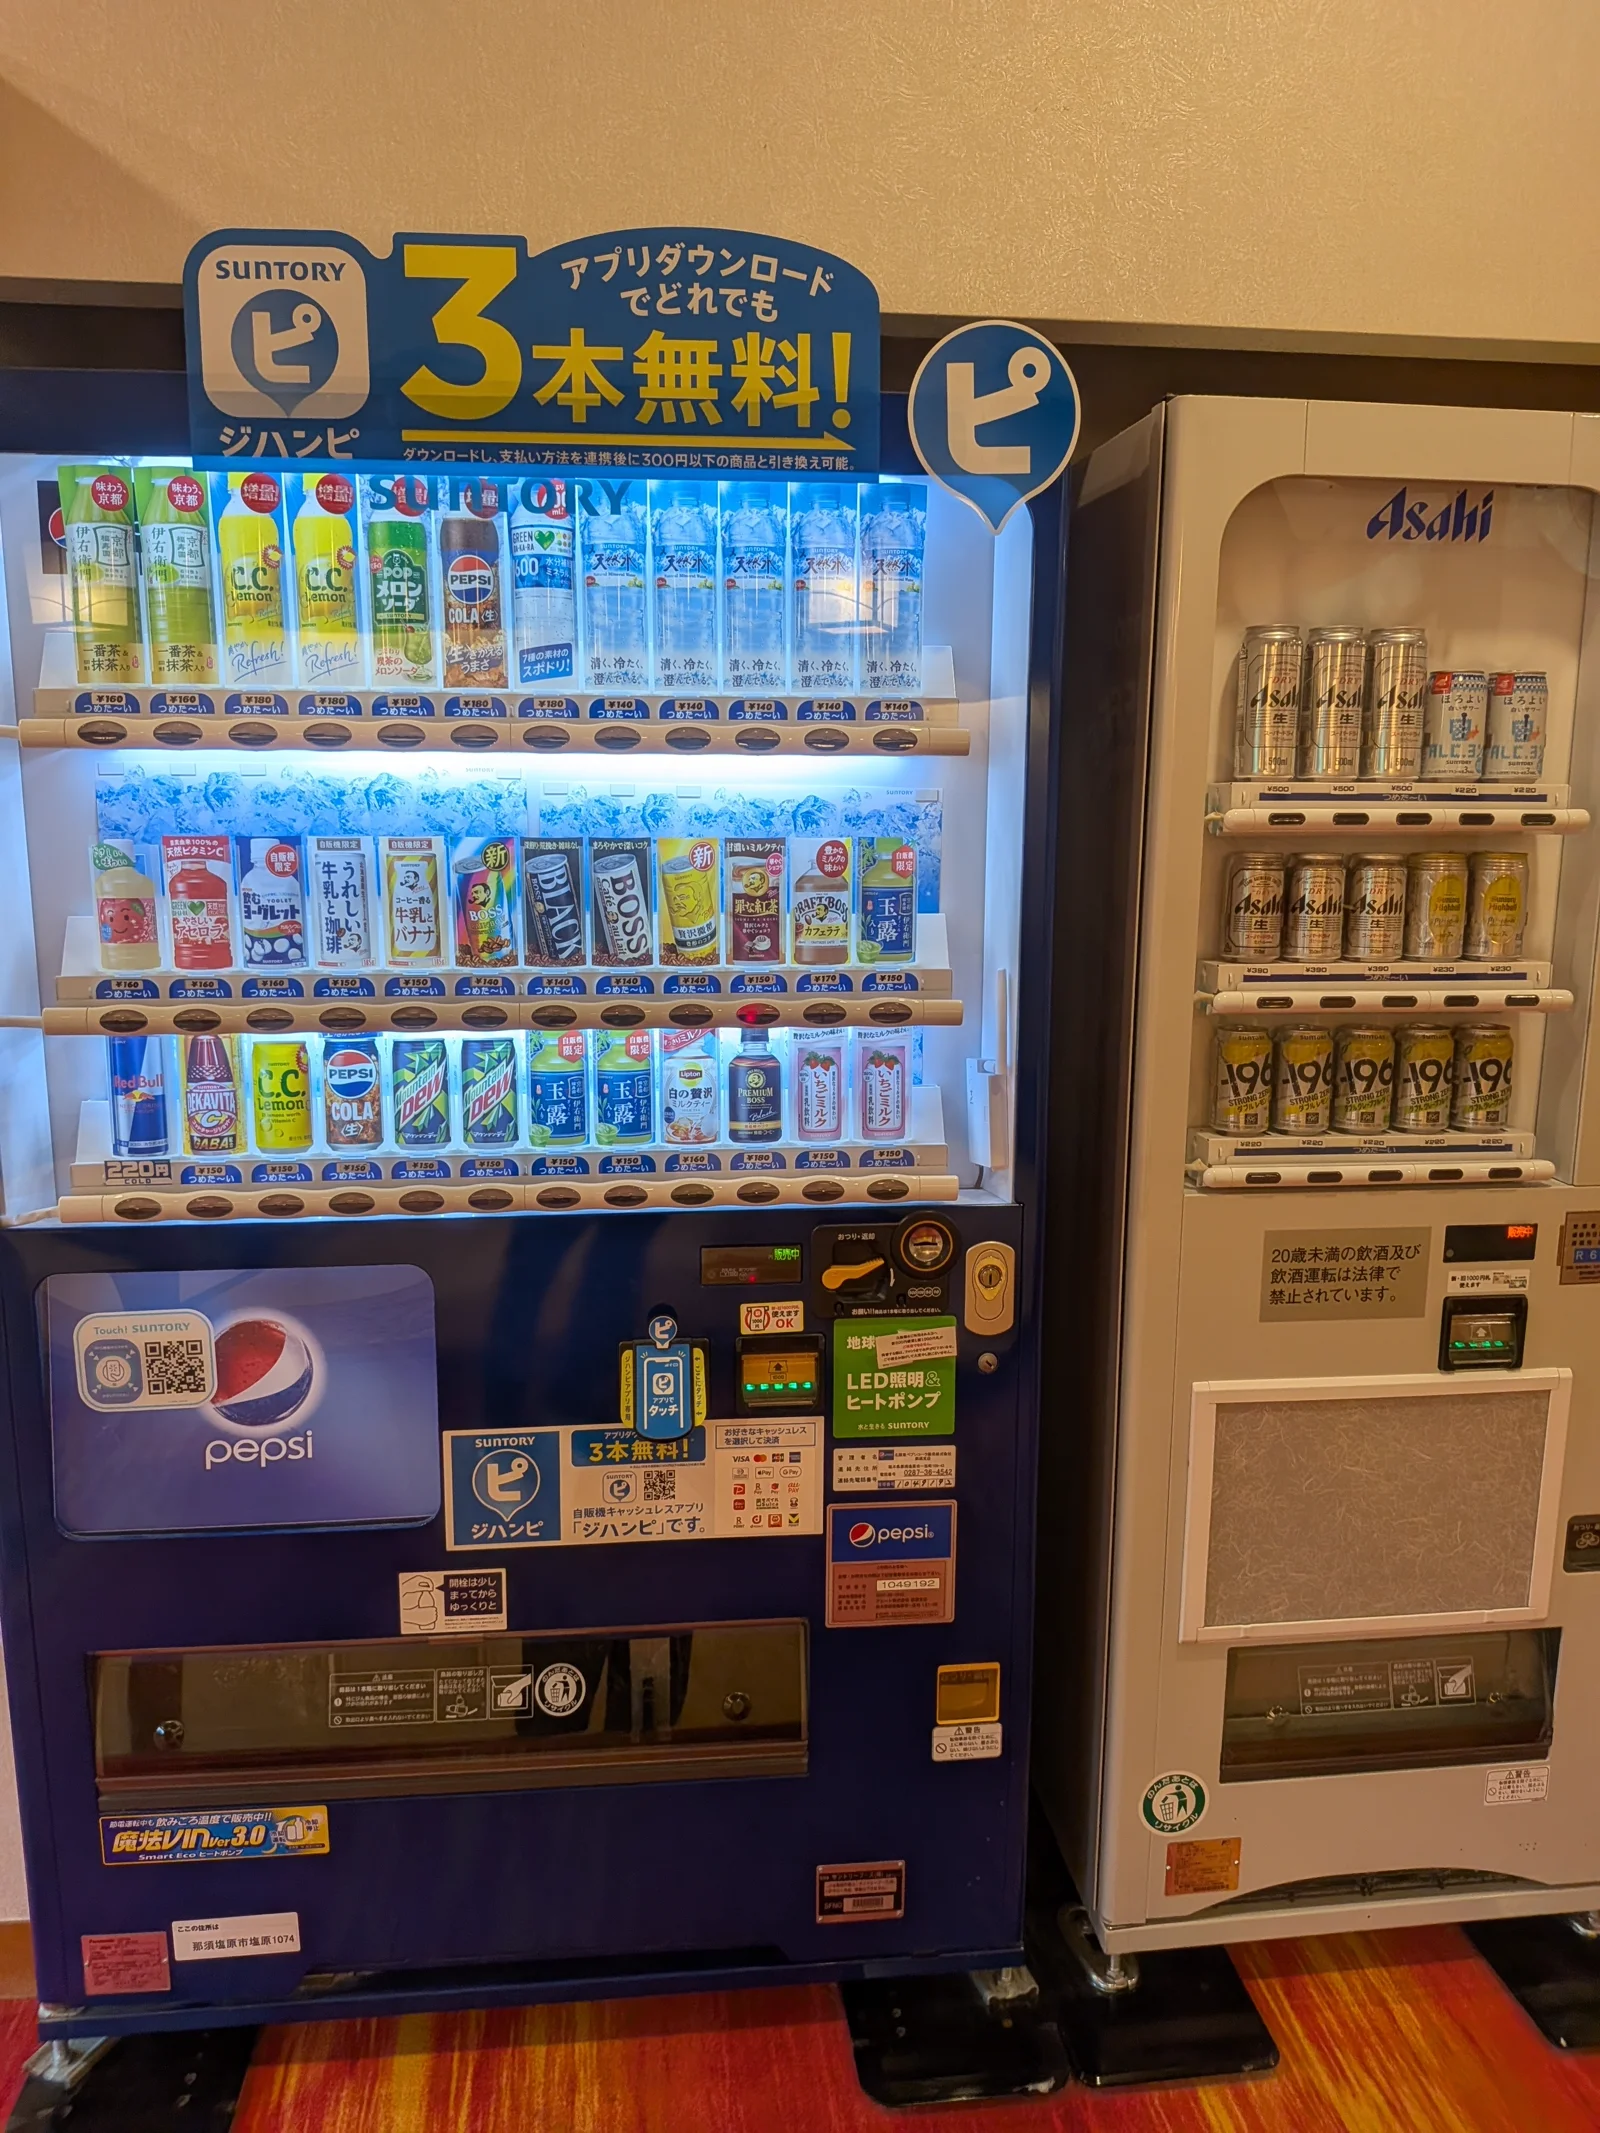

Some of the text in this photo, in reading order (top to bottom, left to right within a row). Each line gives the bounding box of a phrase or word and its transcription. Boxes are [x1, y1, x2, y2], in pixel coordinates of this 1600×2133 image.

[214, 258, 347, 285] SUNTORY
[561, 241, 838, 298] アプリダウンロード
[619, 283, 780, 323] でどれでも
[250, 301, 322, 384] ピ
[945, 345, 1052, 475] ピ
[217, 425, 360, 459] ジハンピ
[97, 493, 123, 505] 京都
[173, 494, 199, 507] 京都
[1366, 486, 1495, 544] Asahi
[592, 553, 638, 573] 天然水
[663, 554, 708, 574] 天然水
[383, 567, 413, 580] POP
[450, 574, 492, 586] PEPSI
[376, 580, 423, 599] メロン
[381, 597, 420, 612] ソーダ
[448, 608, 479, 624] COLA
[522, 648, 569, 664] 7種の素材の
[460, 659, 490, 674] うまさ
[522, 659, 570, 679] スポドリ!
[95, 694, 125, 704] ¥160
[168, 695, 198, 705] ¥160
[243, 695, 273, 705] ¥180
[317, 696, 346, 706] ¥180
[606, 700, 634, 710] ¥140
[676, 701, 704, 711] ¥140
[747, 702, 773, 712] ¥140
[1273, 713, 1288, 725] 生
[1267, 785, 1290, 793] ¥500
[1332, 785, 1355, 793] ¥500
[166, 844, 224, 858] 天然ビタミンC
[269, 851, 296, 863] 自販機
[484, 843, 507, 867] 新
[691, 843, 713, 869] 新
[274, 861, 293, 873] 限定
[821, 854, 846, 865] ミルクの
[895, 860, 914, 872] 限定
[823, 863, 845, 873] 味わい
[243, 891, 261, 904] 飲む
[340, 861, 361, 932] うれしい
[243, 904, 300, 921] ヨーグレット
[321, 860, 343, 955] 牛乳と珈琲
[469, 902, 503, 922] BOSS
[537, 864, 584, 960] BLACK
[609, 869, 648, 954] BOSS
[734, 898, 779, 915] 罪な紅茶
[182, 916, 213, 926] やさしい
[394, 906, 434, 925] 牛乳と
[876, 896, 898, 942] 玉露
[176, 924, 224, 940] アセロラ
[395, 925, 436, 945] バナナ
[804, 926, 841, 937] カフェラテ
[1246, 967, 1269, 975] ¥390
[1305, 966, 1328, 974] ¥390
[1432, 966, 1455, 974] ¥230
[331, 978, 357, 987] ¥150
[402, 978, 429, 987] ¥150
[813, 974, 837, 983] ¥170
[137, 1073, 165, 1088] Bull
[328, 1068, 374, 1080] PEPSI
[679, 1069, 701, 1079] Lipton
[668, 1087, 713, 1100] 白の贅沢
[737, 1087, 774, 1097] PREMIUM
[813, 1070, 829, 1128] いちごミルク
[1345, 1091, 1375, 1106] STRONG
[187, 1091, 236, 1114] DEKAVITA
[544, 1081, 569, 1125] 玉露
[671, 1099, 711, 1108] ミルクティー
[331, 1101, 374, 1121] COLA
[192, 1135, 229, 1150] GABA
[106, 1161, 171, 1179] 220円
[773, 1248, 800, 1261] 販売中
[1271, 1244, 1422, 1264] 20歳未満の飲酒及び
[1269, 1265, 1402, 1285] 飲酒運転は法律で
[1268, 1286, 1398, 1306] 禁止されています。
[771, 1309, 800, 1318] 使えます
[93, 1322, 191, 1336] Touch! SUNTORY
[654, 1318, 673, 1339] ピ
[775, 1317, 795, 1329] OK
[846, 1335, 876, 1350] 地球
[846, 1370, 941, 1390] LED照明&
[846, 1390, 942, 1411] ヒートポンプ
[648, 1404, 679, 1417] タッチ
[724, 1426, 807, 1437] お好きなキャッシュレス
[887, 1421, 930, 1430] SUNTORY
[474, 1436, 536, 1449] SUNTORY
[724, 1436, 780, 1446] を選択して決済
[205, 1429, 314, 1470] pepsi
[588, 1438, 690, 1462] 3本無料!
[732, 1455, 750, 1463] VISA
[486, 1456, 529, 1502] ピ
[573, 1502, 704, 1519] 自販機キャッシュレスアプリ
[470, 1519, 545, 1540] ジハンピ
[573, 1515, 706, 1539] 「ジハンピ」です。
[448, 1576, 497, 1589] 開栓は少し
[881, 1579, 936, 1590] 1049192
[449, 1589, 497, 1601] まってから
[449, 1601, 497, 1612] ゆっくりと
[542, 1666, 580, 1684] のんだあとは
[544, 1699, 578, 1713] リサイクル
[1147, 1775, 1199, 1800] のんだあとは
[155, 1811, 272, 1828] 飲みごろ温度で販売中!!
[1154, 1812, 1199, 1832] リサイクル
[209, 1835, 231, 1848] Ver
[230, 1824, 267, 1846] 3.0
[138, 1848, 244, 1862] Smart Eco ヒートポンプ
[177, 1923, 220, 1934] ここの住所は
[191, 1933, 295, 1952] 那須塩原市塩原1074
